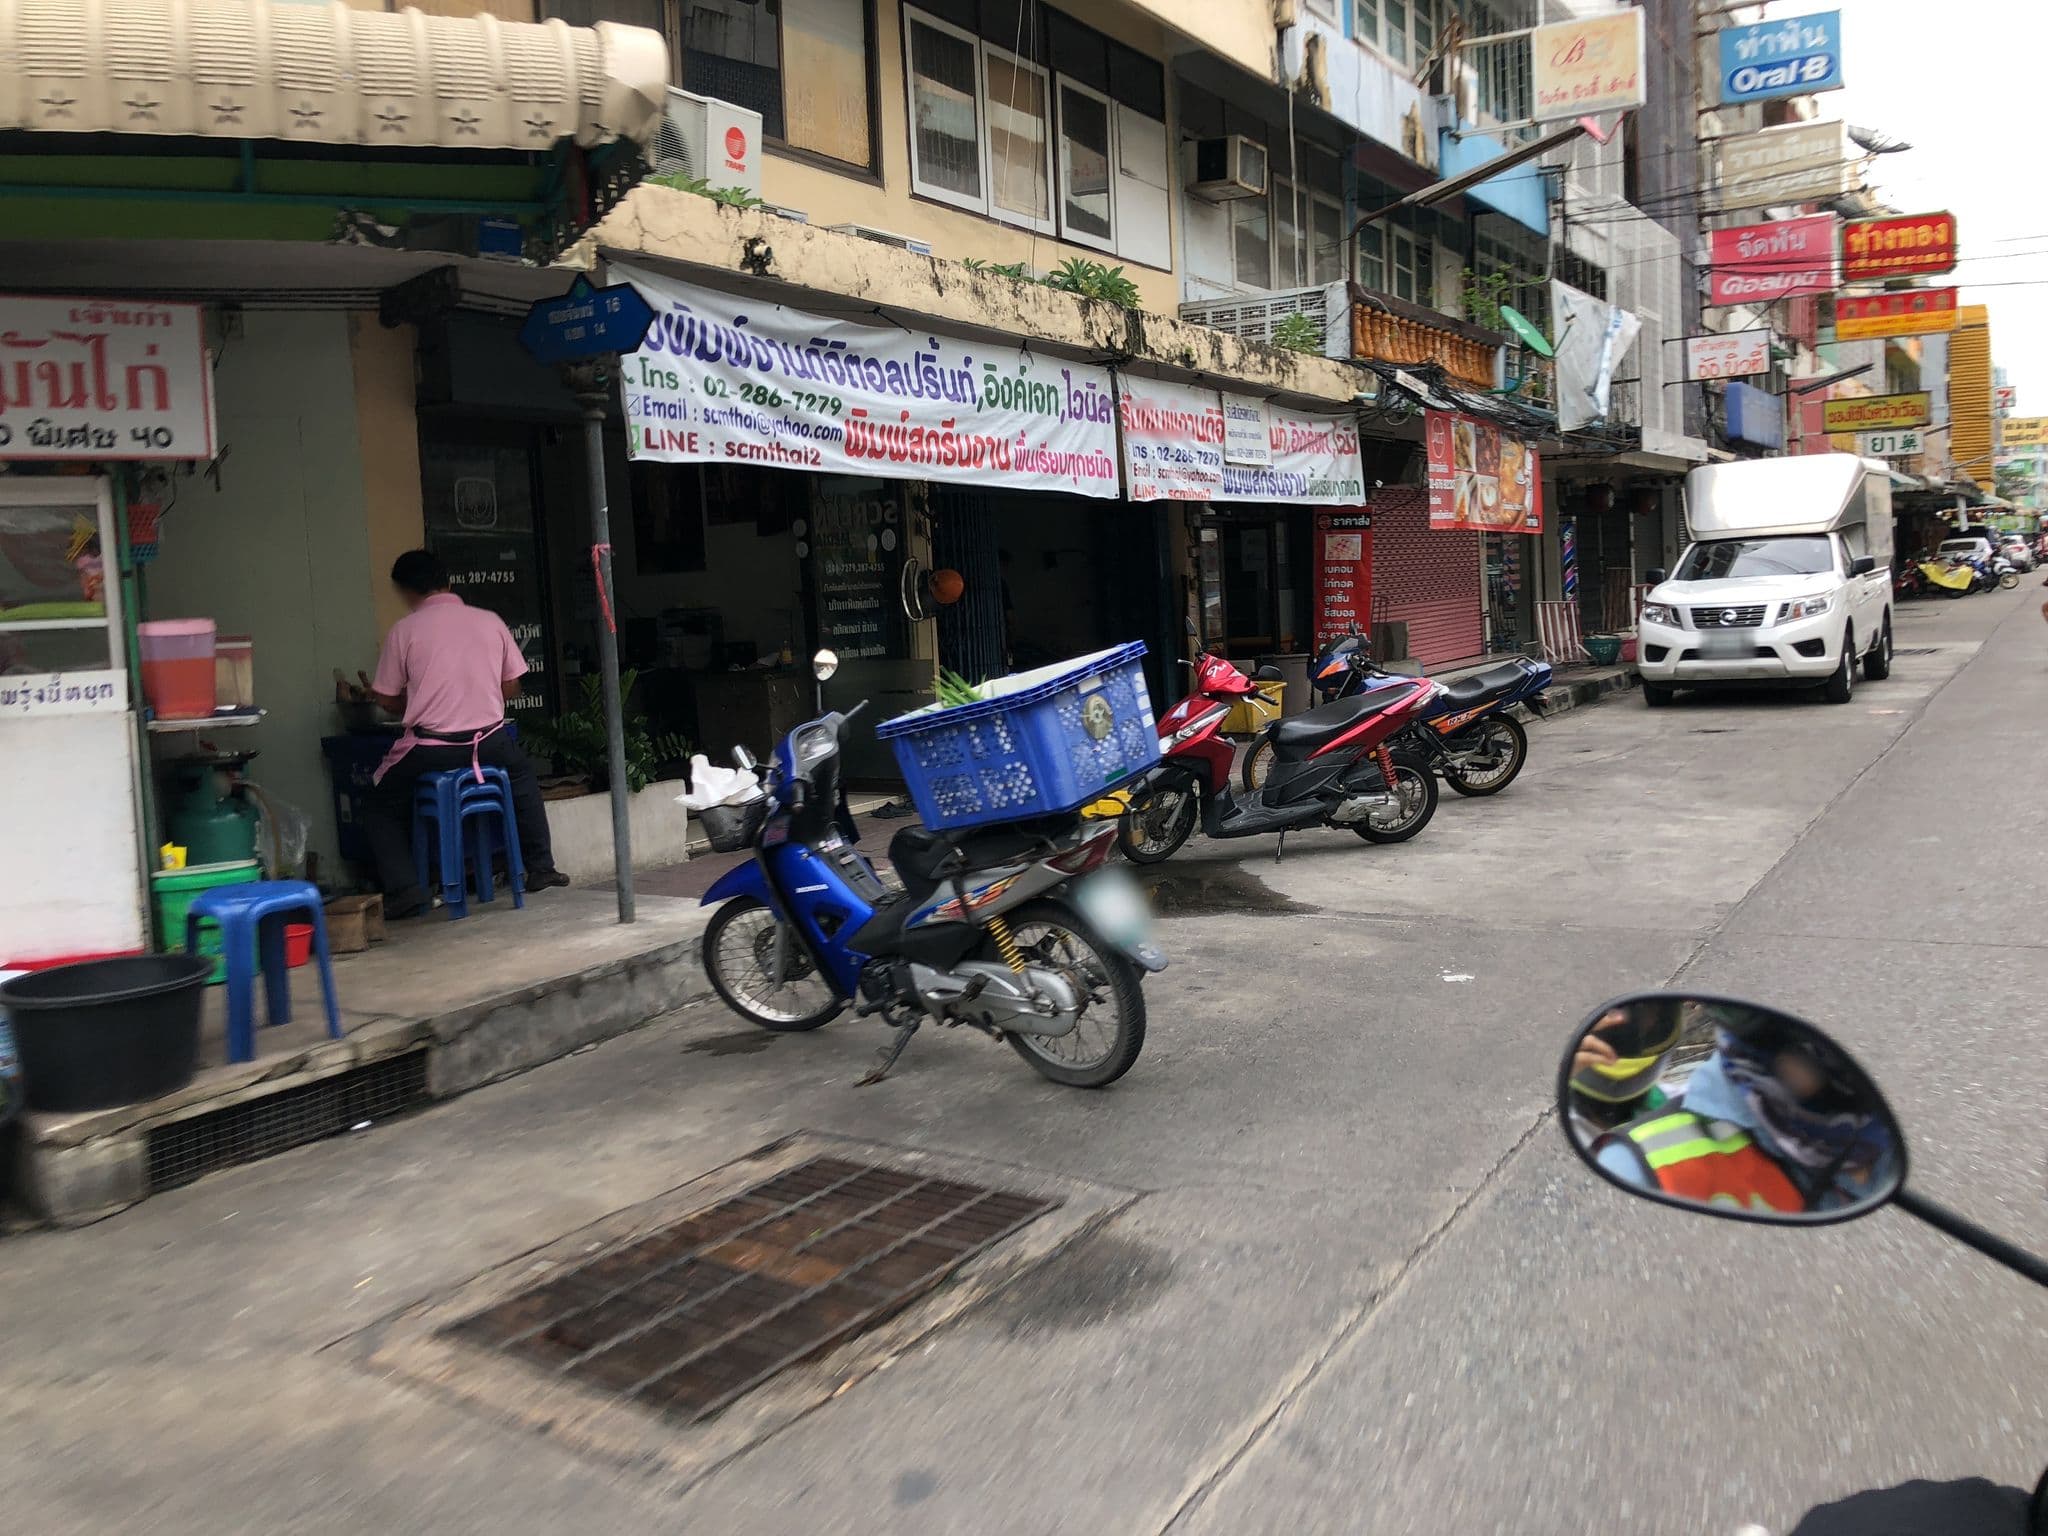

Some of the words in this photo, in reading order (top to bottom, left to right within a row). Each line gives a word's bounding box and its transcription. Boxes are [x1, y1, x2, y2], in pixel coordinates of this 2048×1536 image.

[1735, 20, 1830, 60] ทำฟัน
[1735, 226, 1807, 259] จัดฟัน
[639, 356, 680, 390] โทร
[703, 374, 843, 416] 02-286-7279
[27, 417, 119, 449] พิเศษ
[130, 426, 174, 448] 40
[643, 394, 687, 421] Email
[703, 406, 843, 442] scmthai@yahoo.com
[644, 427, 699, 454] LINE
[725, 441, 822, 467] scmthai2
[1157, 446, 1221, 467] 02-286-7279
[1871, 436, 1896, 453] ยา
[1134, 484, 1159, 499] LINE
[1333, 515, 1370, 526] ราคาส่ง
[468, 570, 515, 584] 287-4755
